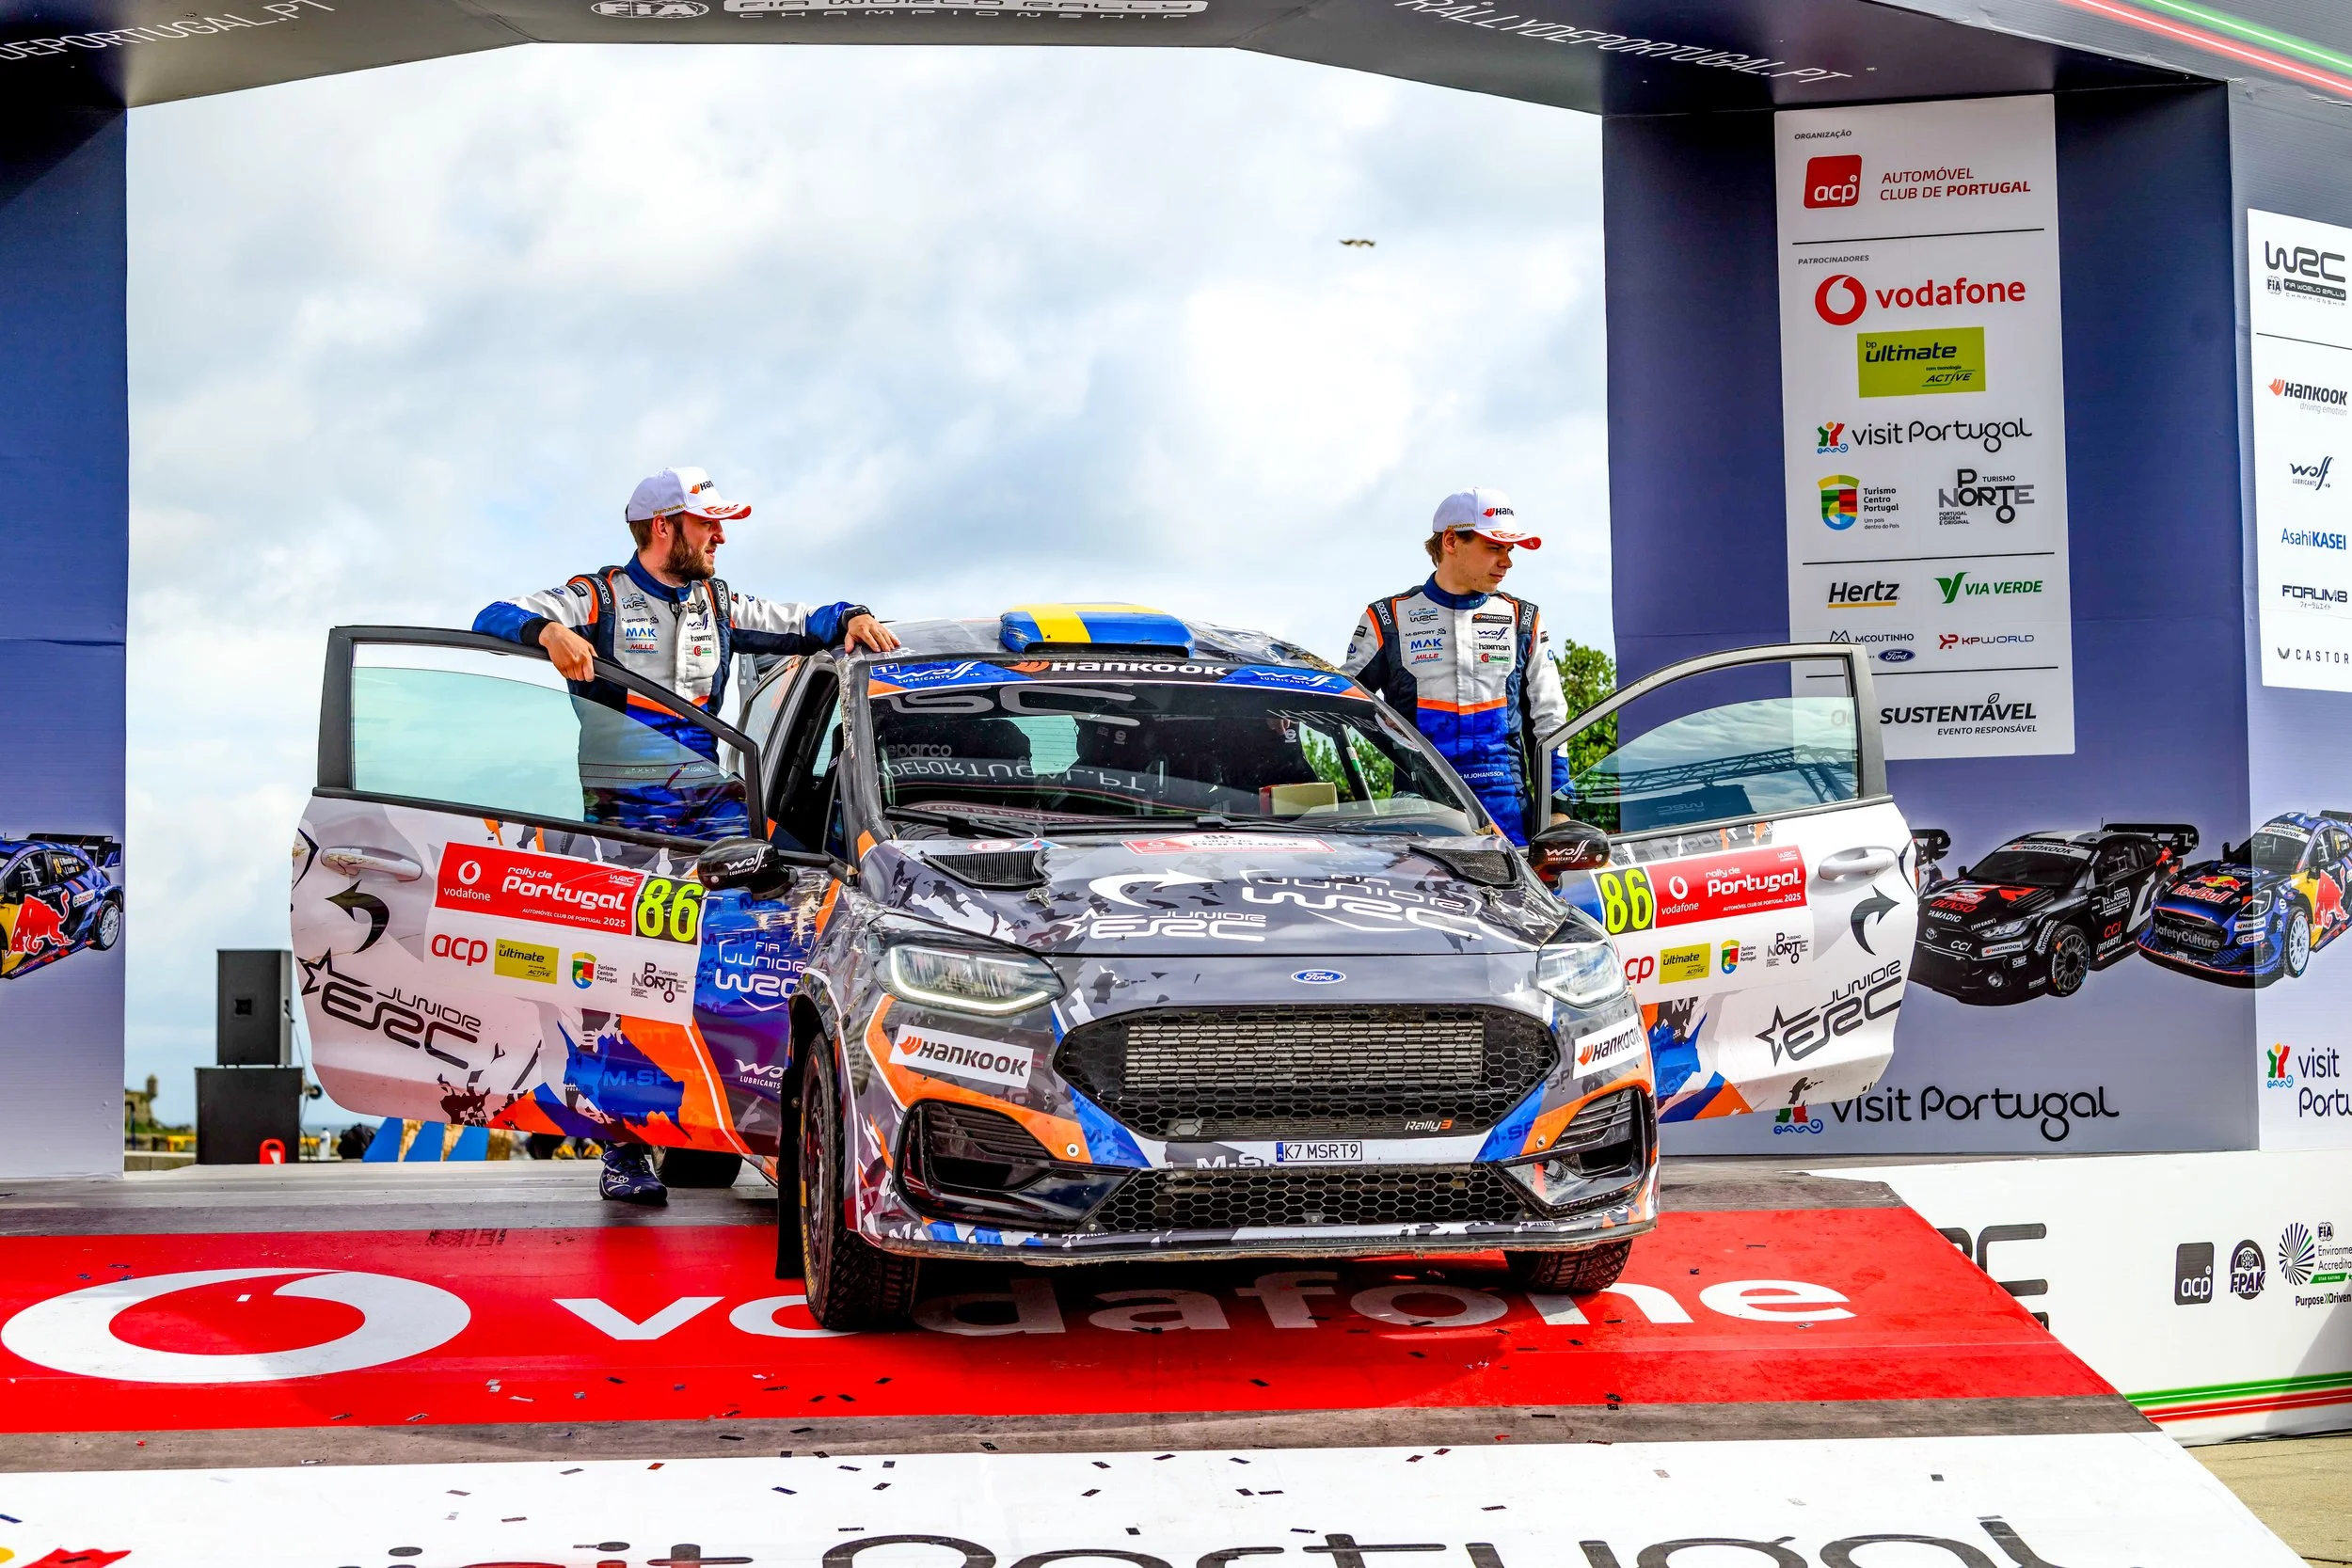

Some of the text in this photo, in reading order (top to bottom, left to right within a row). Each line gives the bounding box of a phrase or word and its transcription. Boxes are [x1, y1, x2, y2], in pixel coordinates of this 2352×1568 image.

[739, 10, 1187, 19] CHAMPIONSHIP
[1794, 130, 1851, 140] ORGANIZAÇÃO
[1882, 166, 1974, 184] AUTOMÓVEL
[1814, 184, 1856, 203] acp
[1880, 181, 2031, 200] CLUB DE PORTUGAL
[1798, 255, 1869, 265] PATROCINADORES
[2265, 241, 2346, 283] WRC
[1875, 277, 2026, 309] vodafone
[1866, 341, 1877, 350] bp
[1866, 341, 1957, 363] ultimate
[2300, 402, 2347, 416] driving emotion
[1851, 418, 2032, 452] visit Portugal
[1864, 486, 1897, 496] Turismo
[1864, 496, 1891, 504] Centro
[1864, 503, 1899, 513] Portugal
[2281, 528, 2346, 550] AsahiKASEI
[1828, 581, 1899, 603] Hertz
[1964, 579, 2043, 595] VIA VERDE
[2282, 584, 2348, 603] FORUM8
[626, 627, 657, 638] MAK
[1854, 633, 1915, 642] MCOUTINHO
[1411, 639, 1442, 650] MAK
[898, 674, 950, 684] LUBRICANTS
[1260, 676, 1310, 686] LUBRICANTS
[1937, 724, 2037, 736] EVENTO RESPONSÁVEL
[507, 866, 553, 879] rally de
[729, 866, 755, 876] LUBRICANTS
[1706, 866, 1740, 879] rally de
[1708, 868, 1802, 898] Portugal
[443, 886, 491, 902] vodafone
[501, 876, 627, 911] Portugal
[1258, 877, 1466, 910] JUNIOR
[1599, 868, 1653, 934] 86
[1763, 898, 1784, 907] PORTUGAL
[1785, 893, 1802, 903] 2025
[636, 878, 704, 942] 86
[1661, 901, 1699, 916] vodafone
[1931, 899, 1978, 913] DENSO
[522, 908, 553, 917] AUTOMÓVEL
[575, 916, 601, 925] PORTUGAL
[603, 917, 626, 927] 2025
[1150, 911, 1267, 923] JUNIOR
[2035, 920, 2054, 951] Panasonic
[2154, 924, 2220, 949] SafetyCulture
[431, 933, 487, 966] acp
[499, 946, 545, 963] ultimate
[755, 942, 780, 953] FIA
[1662, 952, 1699, 966] ultimate
[597, 964, 617, 973] Turismo
[1625, 956, 1654, 984] cp
[596, 974, 618, 984] Portugal
[1296, 970, 1340, 984] Ford
[1822, 959, 1901, 1008] JUNIOR
[377, 987, 482, 1033] JUNIOR
[2297, 1047, 2341, 1079] visit
[739, 1075, 781, 1089] LUBRICANTS
[1920, 1085, 2120, 1142] Portugal
[1405, 1119, 1453, 1132] Rally3
[1284, 1144, 1359, 1158] K7 MSRT9
[2181, 1276, 2211, 1300] acp
[2229, 1270, 2266, 1295] FPAK
